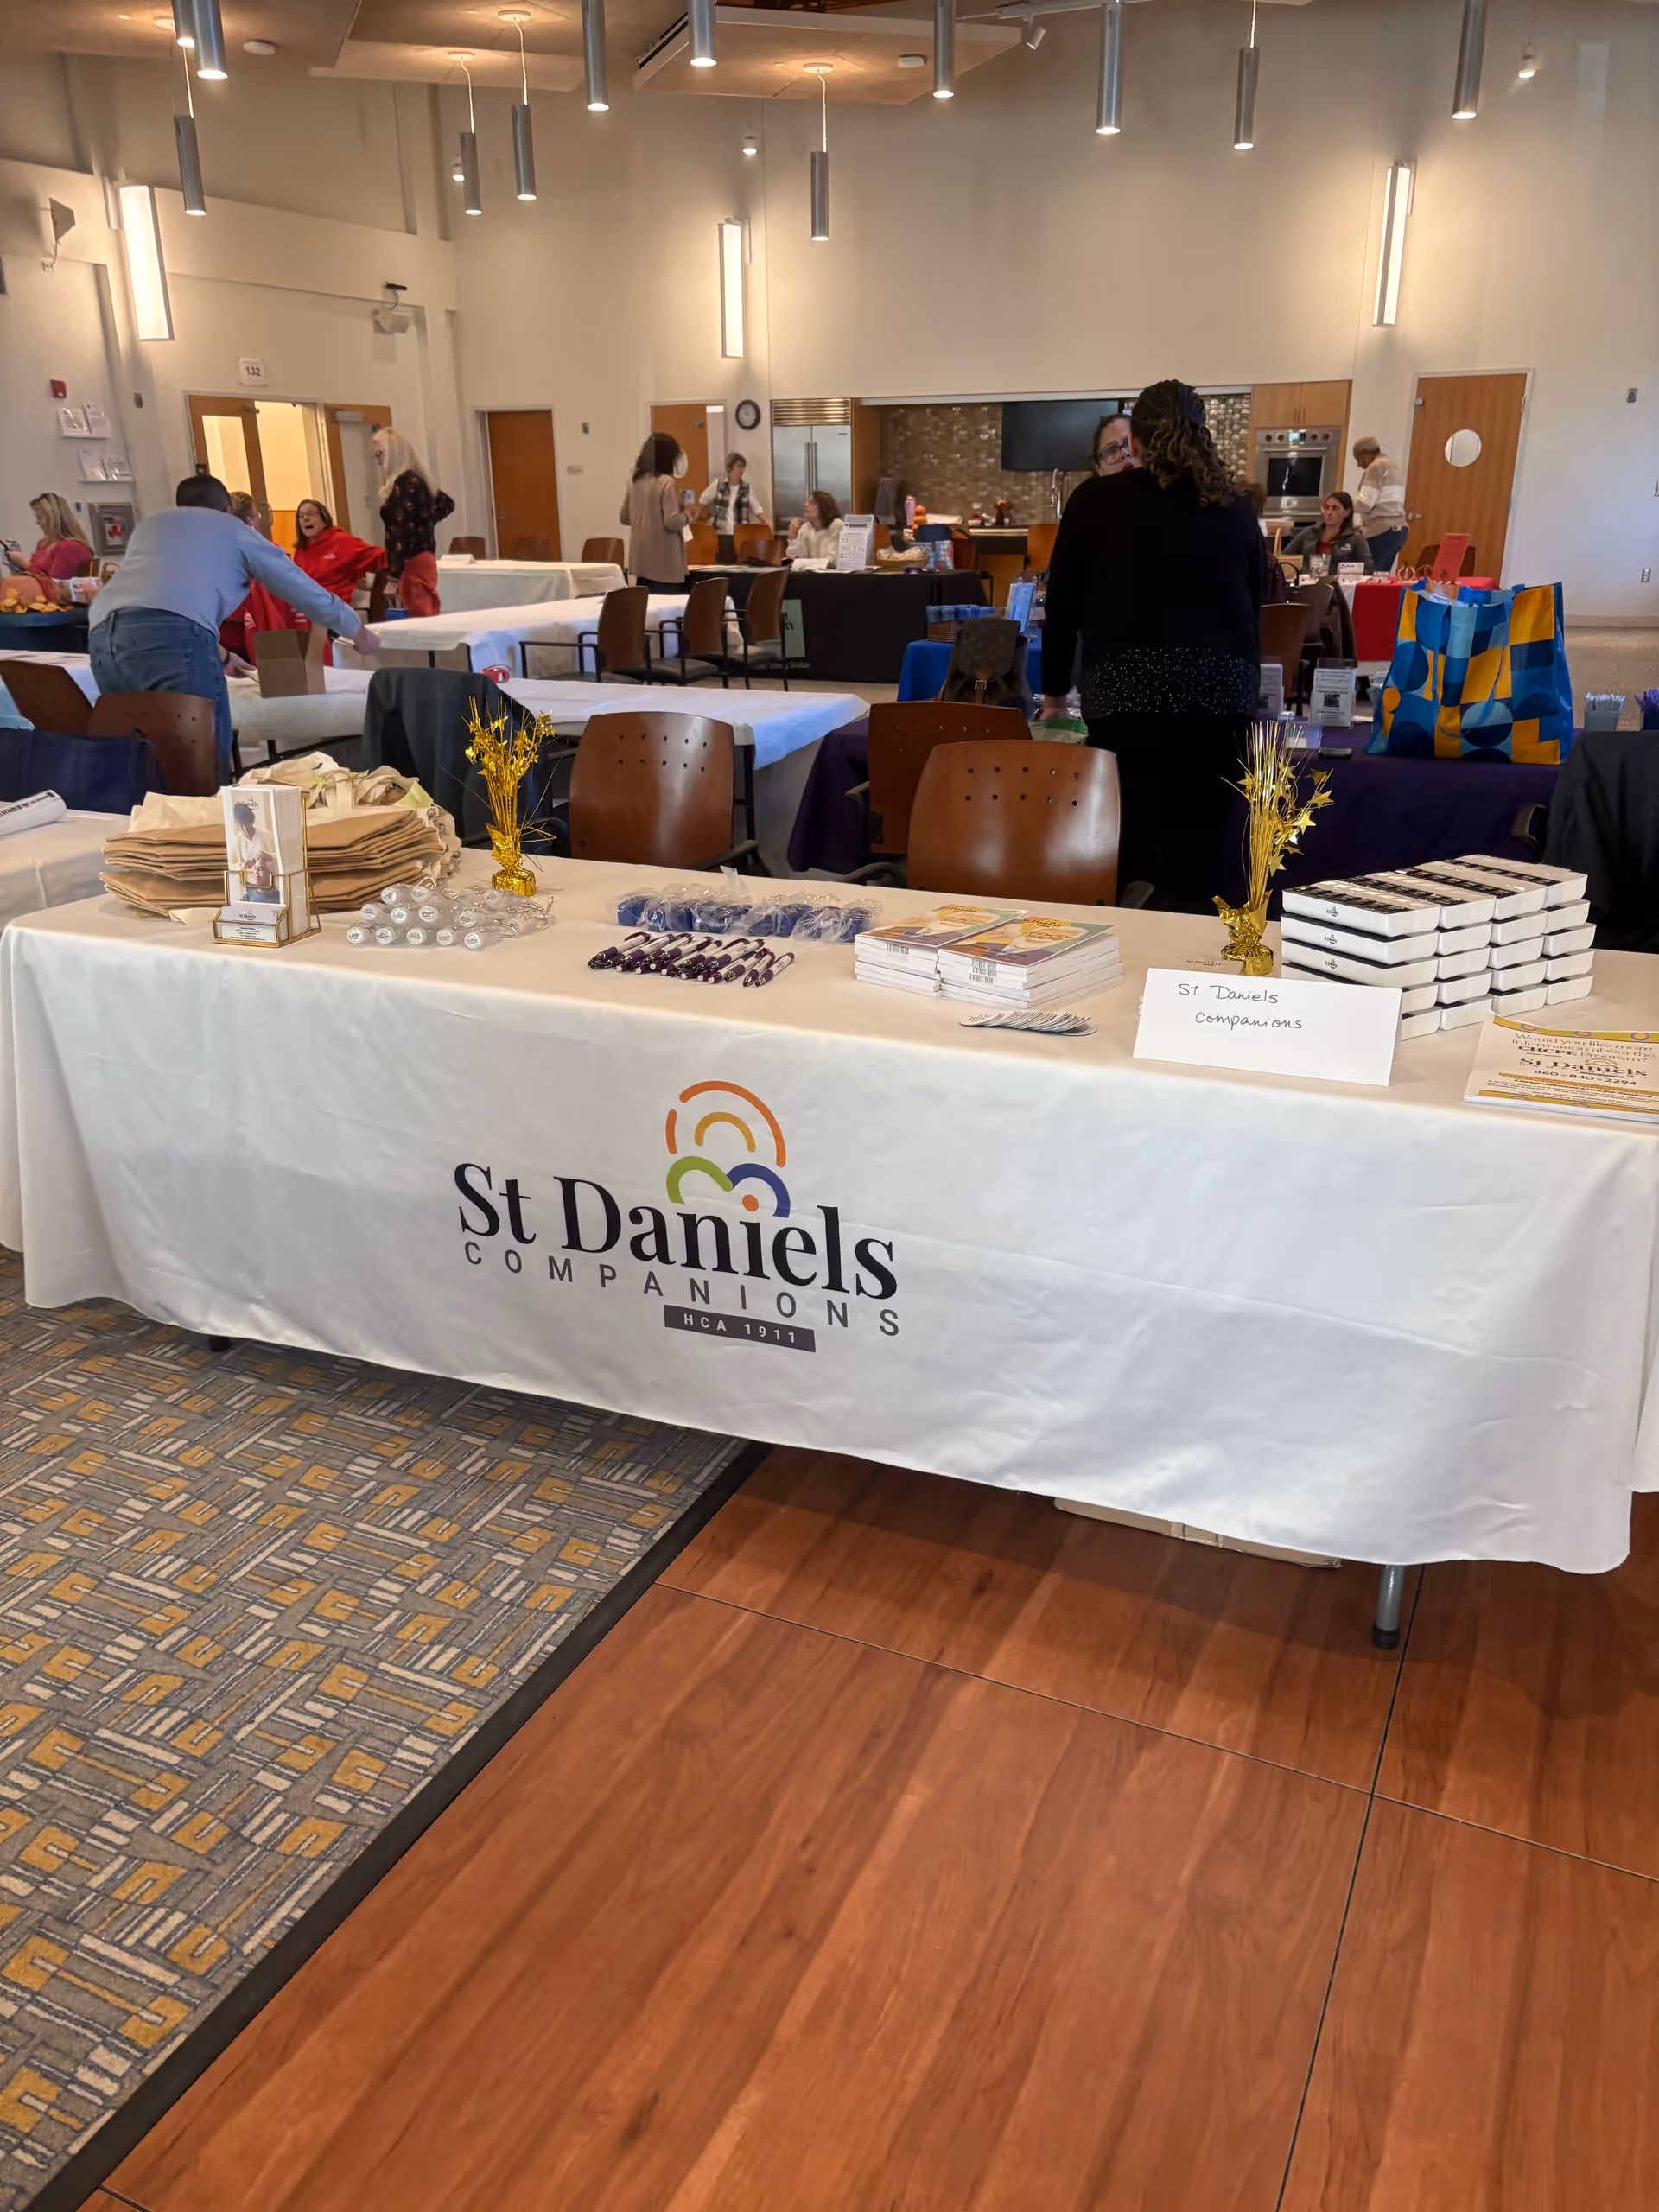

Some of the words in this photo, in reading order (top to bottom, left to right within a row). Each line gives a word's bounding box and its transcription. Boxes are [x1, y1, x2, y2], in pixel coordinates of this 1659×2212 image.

[245, 366, 261, 377] 132
[1210, 985, 1279, 1003] Daniels
[1515, 1032, 1558, 1044] Would
[1518, 1046, 1578, 1056] CHCPE
[1552, 1061, 1648, 1076] Daniels
[454, 1162, 537, 1245] St
[553, 1175, 898, 1300] Daniels
[464, 1241, 899, 1337] COMPANIONS
[683, 1313, 727, 1332] HCA
[744, 1324, 795, 1343] 1911
